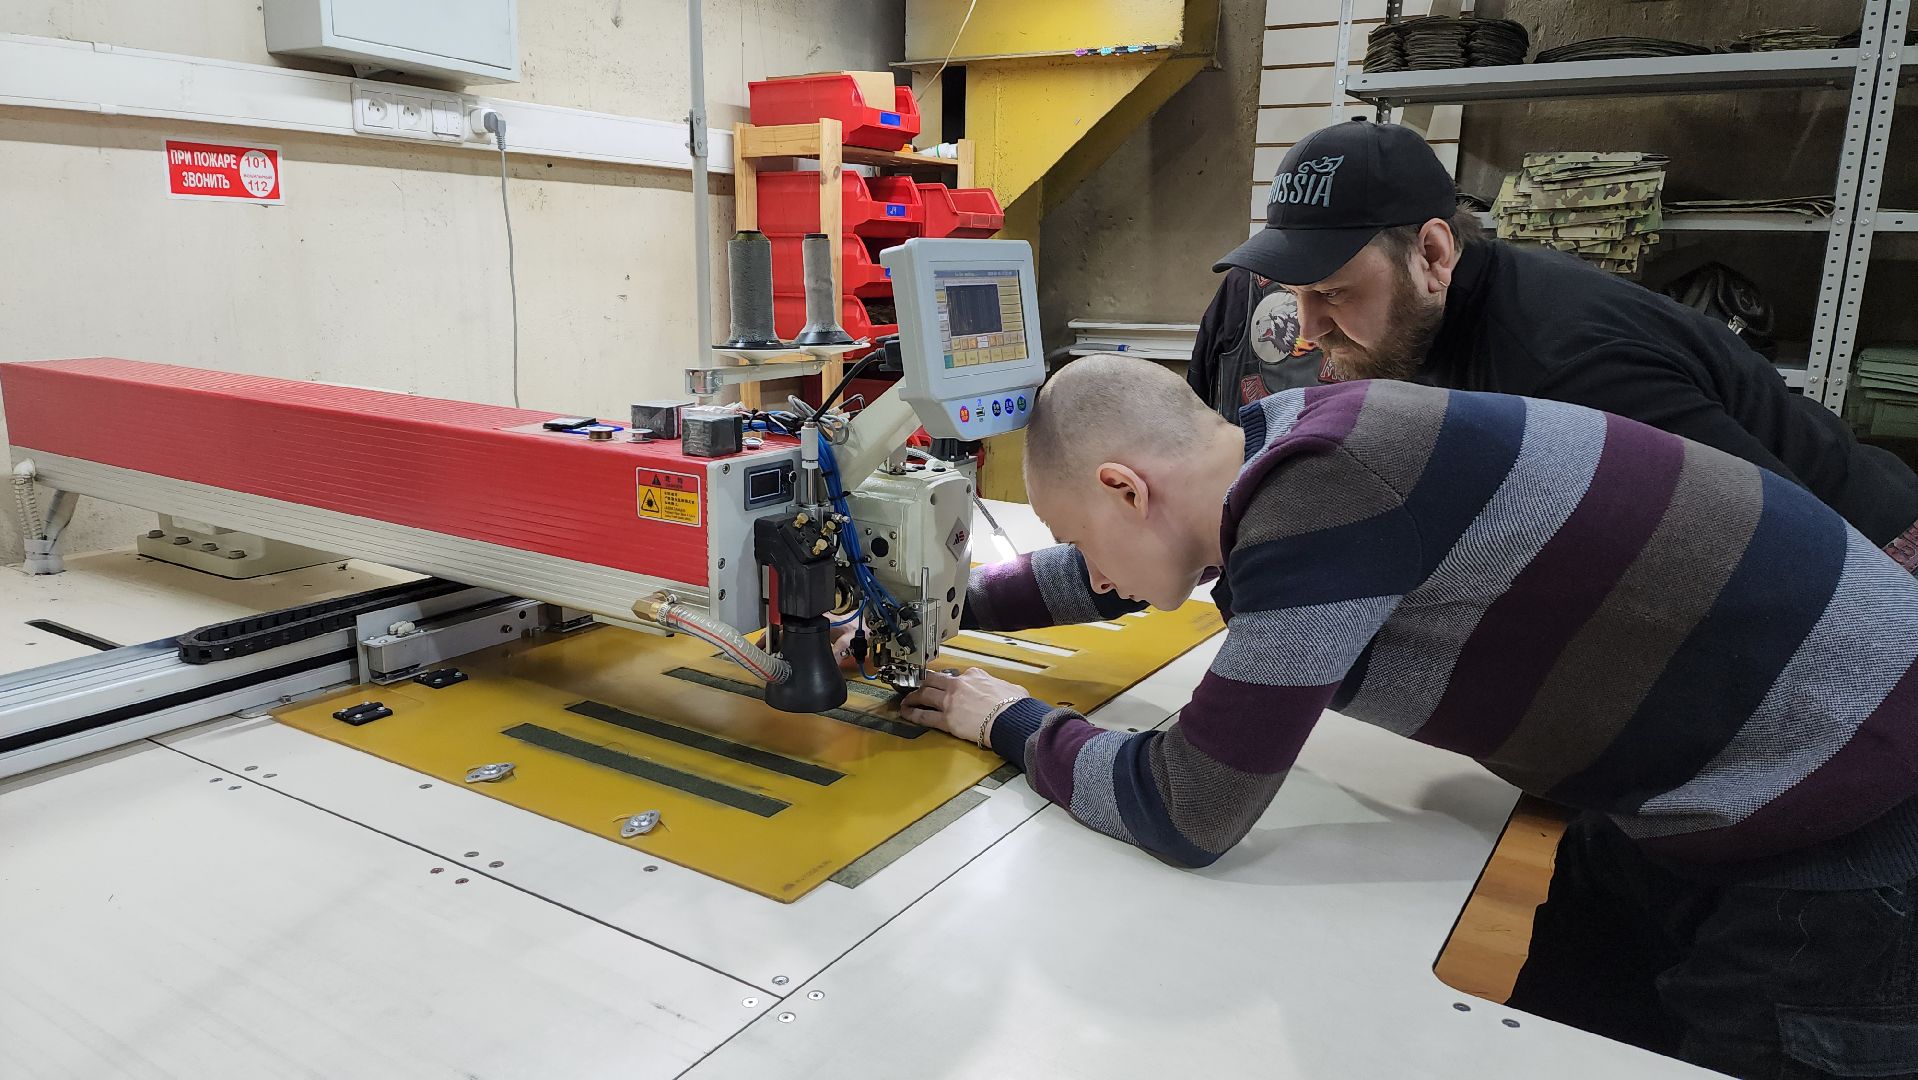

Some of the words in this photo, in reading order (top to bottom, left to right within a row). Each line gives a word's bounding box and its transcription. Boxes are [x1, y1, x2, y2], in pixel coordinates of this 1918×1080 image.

[170, 150, 192, 165] ПРИ
[193, 152, 237, 169] ПОЖАРЕ
[245, 156, 267, 168] 101
[182, 171, 230, 188] ЗВОНИТЬ
[248, 180, 268, 192] 112
